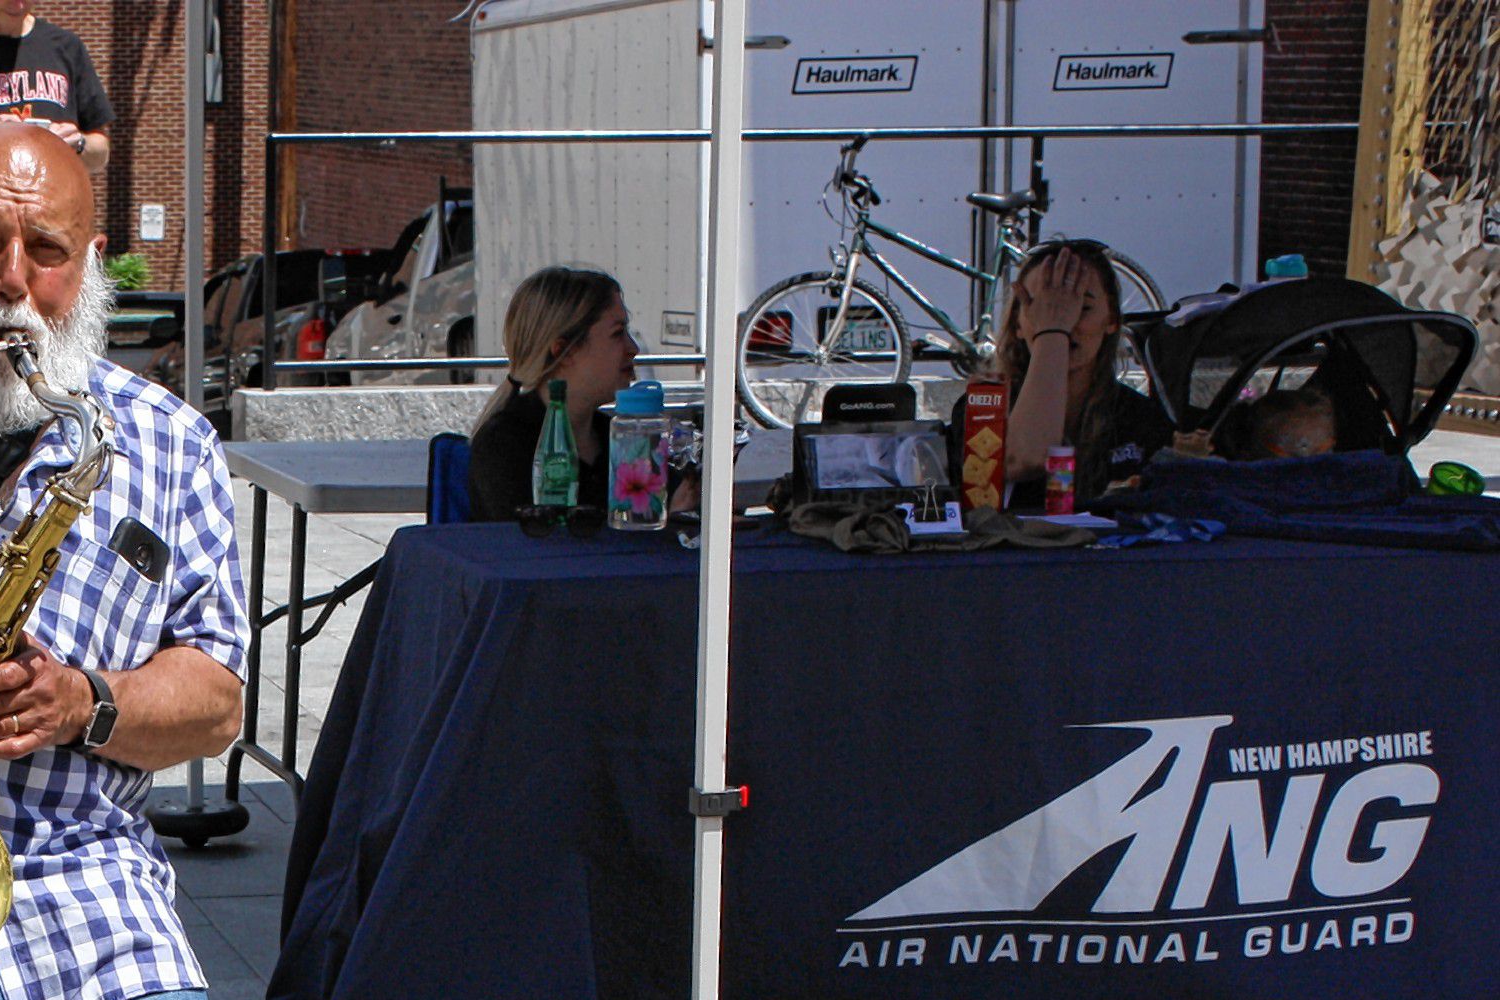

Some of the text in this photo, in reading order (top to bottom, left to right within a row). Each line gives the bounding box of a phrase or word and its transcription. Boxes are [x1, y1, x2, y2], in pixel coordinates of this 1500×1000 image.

[805, 64, 899, 83] Haulmark
[1066, 61, 1156, 80] Haulmark
[840, 402, 896, 411] GoANG.com
[1228, 730, 1434, 773] NEW HAMPSHIRE
[844, 715, 1441, 921] ANG
[838, 911, 1415, 969] AIR NATIONAL GUARD
